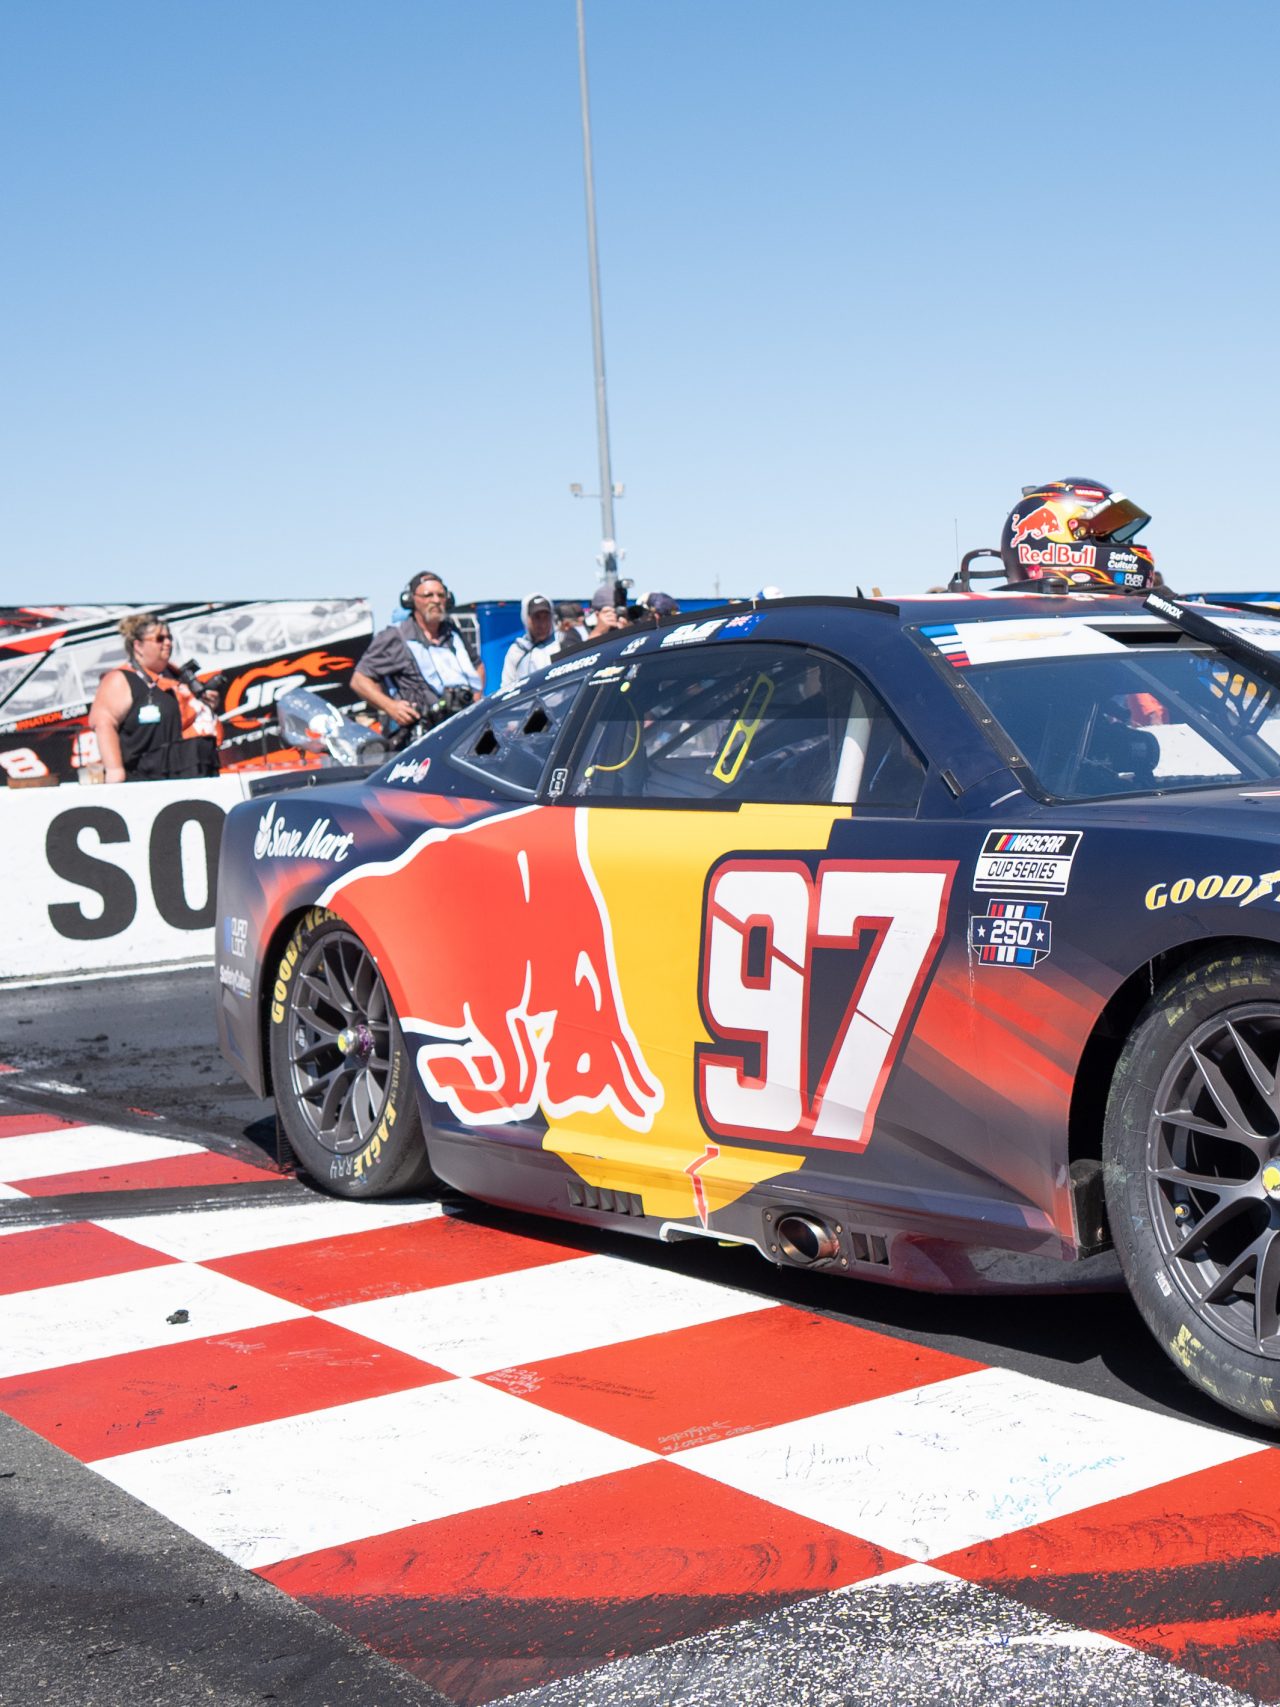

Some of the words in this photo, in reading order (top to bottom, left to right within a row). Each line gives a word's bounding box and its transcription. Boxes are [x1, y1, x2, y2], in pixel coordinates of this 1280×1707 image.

[1018, 544, 1055, 565] Red
[1055, 544, 1096, 567] Bull
[1108, 561, 1138, 571] Culture
[1110, 552, 1138, 563] Safety
[267, 816, 302, 858] Save
[294, 818, 354, 862] Mart
[1010, 834, 1067, 853] NASCAR
[988, 860, 1012, 878] CUP
[1013, 861, 1057, 879] SERIES
[990, 919, 1034, 946] 250
[700, 860, 959, 1153] 97
[354, 1100, 398, 1178] EAGLE
